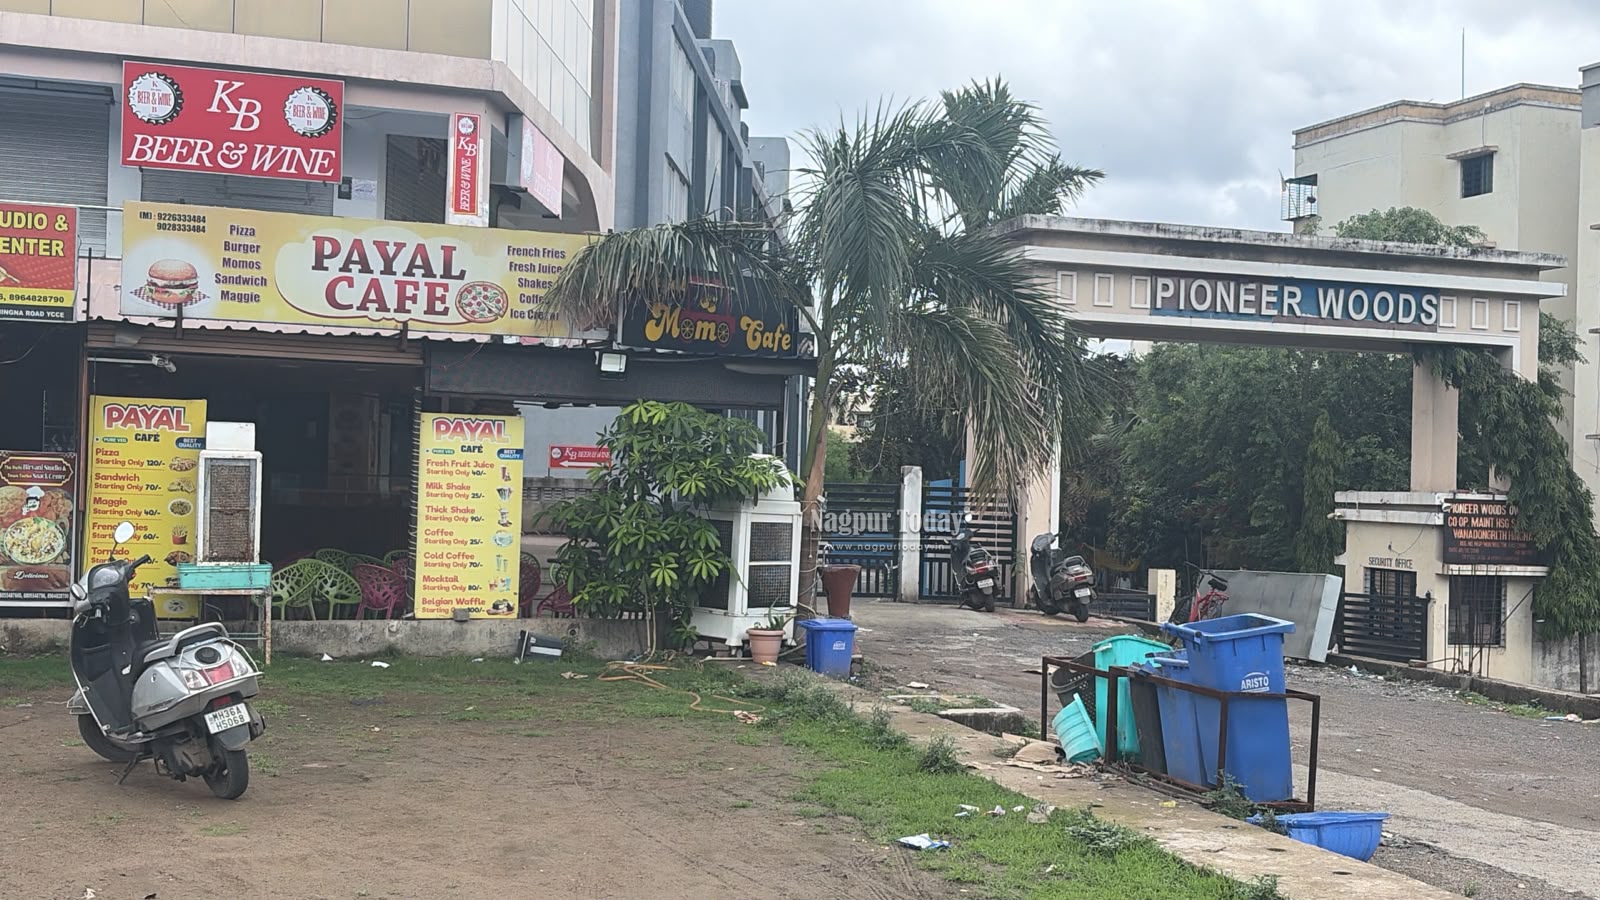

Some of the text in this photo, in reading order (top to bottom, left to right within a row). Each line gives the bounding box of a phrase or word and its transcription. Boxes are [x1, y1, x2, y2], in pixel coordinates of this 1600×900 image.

[137, 91, 172, 106] BEER & WINE
[206, 80, 262, 132] KB
[293, 104, 326, 120] BEER & WINE
[458, 136, 477, 156] KB
[127, 134, 336, 176] BEER & WINE
[461, 158, 471, 180] WINE
[460, 189, 470, 212] BEER
[54, 214, 69, 232] &
[157, 213, 206, 224] 9226333484
[156, 222, 206, 233] 9028333484
[230, 224, 256, 237] Pizza
[224, 241, 261, 254] Burger
[507, 245, 566, 260] French Fries
[222, 257, 262, 270] Momos
[312, 236, 467, 280] PAYAL
[509, 261, 563, 274] Fresh Juice
[214, 273, 268, 287] Sandwich
[518, 278, 553, 289] Shakes
[9, 294, 64, 303] 8964828790
[220, 290, 261, 304] Maggie
[324, 275, 450, 316] CAFE
[1156, 277, 1438, 325] PIONEER WOODS
[510, 309, 525, 319] Ice
[740, 316, 792, 352] Cafe
[104, 404, 190, 432] PAYAL
[432, 417, 512, 443] PAYAL
[96, 448, 119, 456] Pizza
[96, 458, 126, 466] Starting
[426, 459, 449, 467] Fresh
[94, 473, 140, 482] Sandwich
[94, 483, 125, 491] Starting
[126, 484, 144, 492] Only
[93, 497, 128, 507] Maggie
[93, 508, 124, 516] Starting
[451, 506, 475, 514] Shake
[1448, 503, 1478, 514] PIONEER
[1481, 505, 1506, 515] WOODS
[1496, 518, 1509, 528] HSG
[1369, 557, 1412, 569] SECURITY OFFICE
[14, 571, 48, 579] Delicious
[422, 598, 452, 606] Belgian
[1241, 676, 1269, 690] ARISTO
[212, 706, 242, 721] MH36A
[216, 715, 245, 730] H5068
